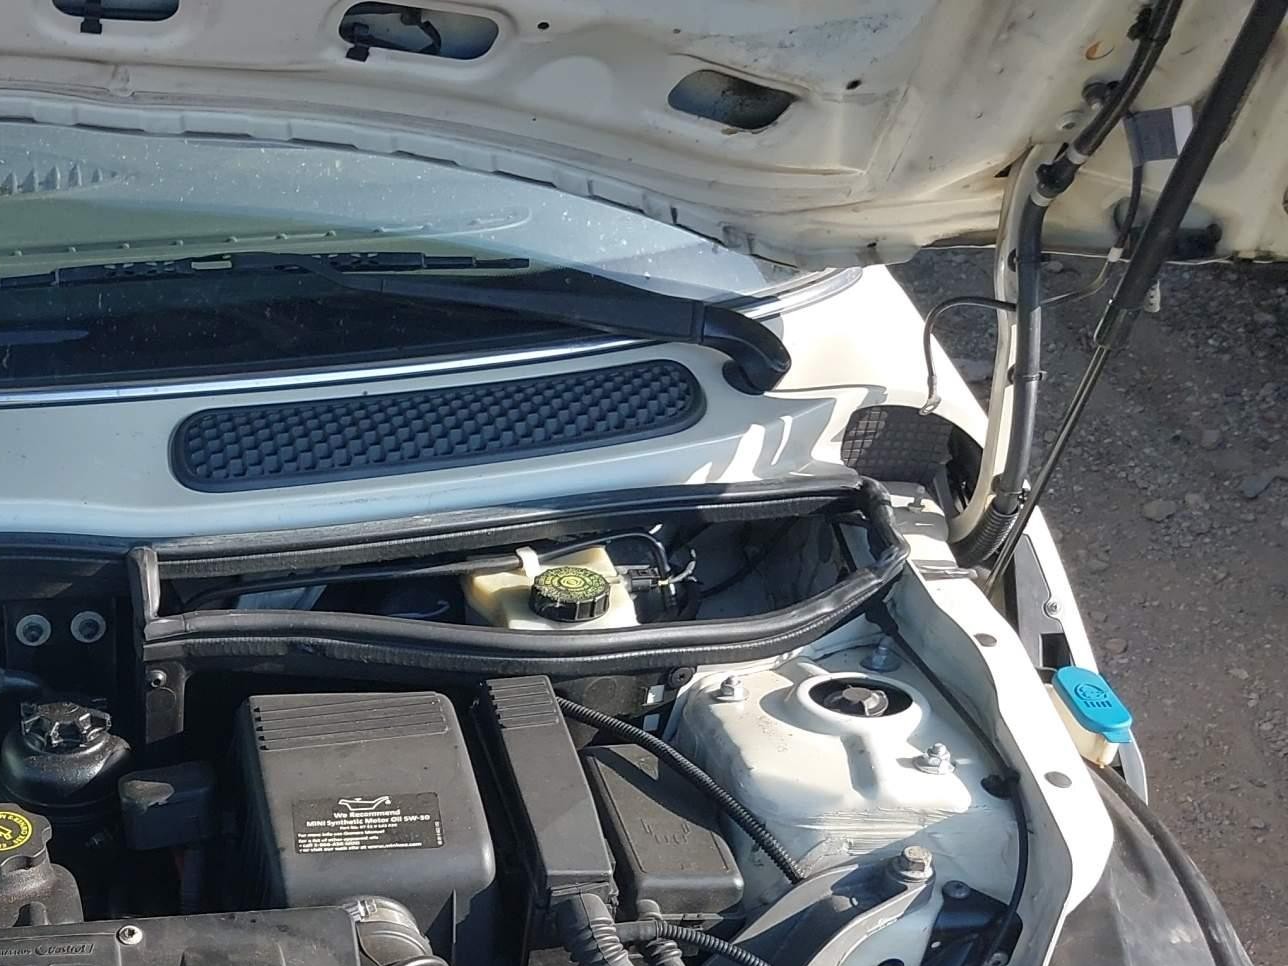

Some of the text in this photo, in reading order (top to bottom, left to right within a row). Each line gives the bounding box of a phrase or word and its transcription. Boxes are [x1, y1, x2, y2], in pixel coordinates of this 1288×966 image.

[349, 809, 401, 818] Recommend
[327, 818, 364, 827] Synthetic
[365, 817, 389, 825] Motor
[404, 814, 431, 822] 5W-30
